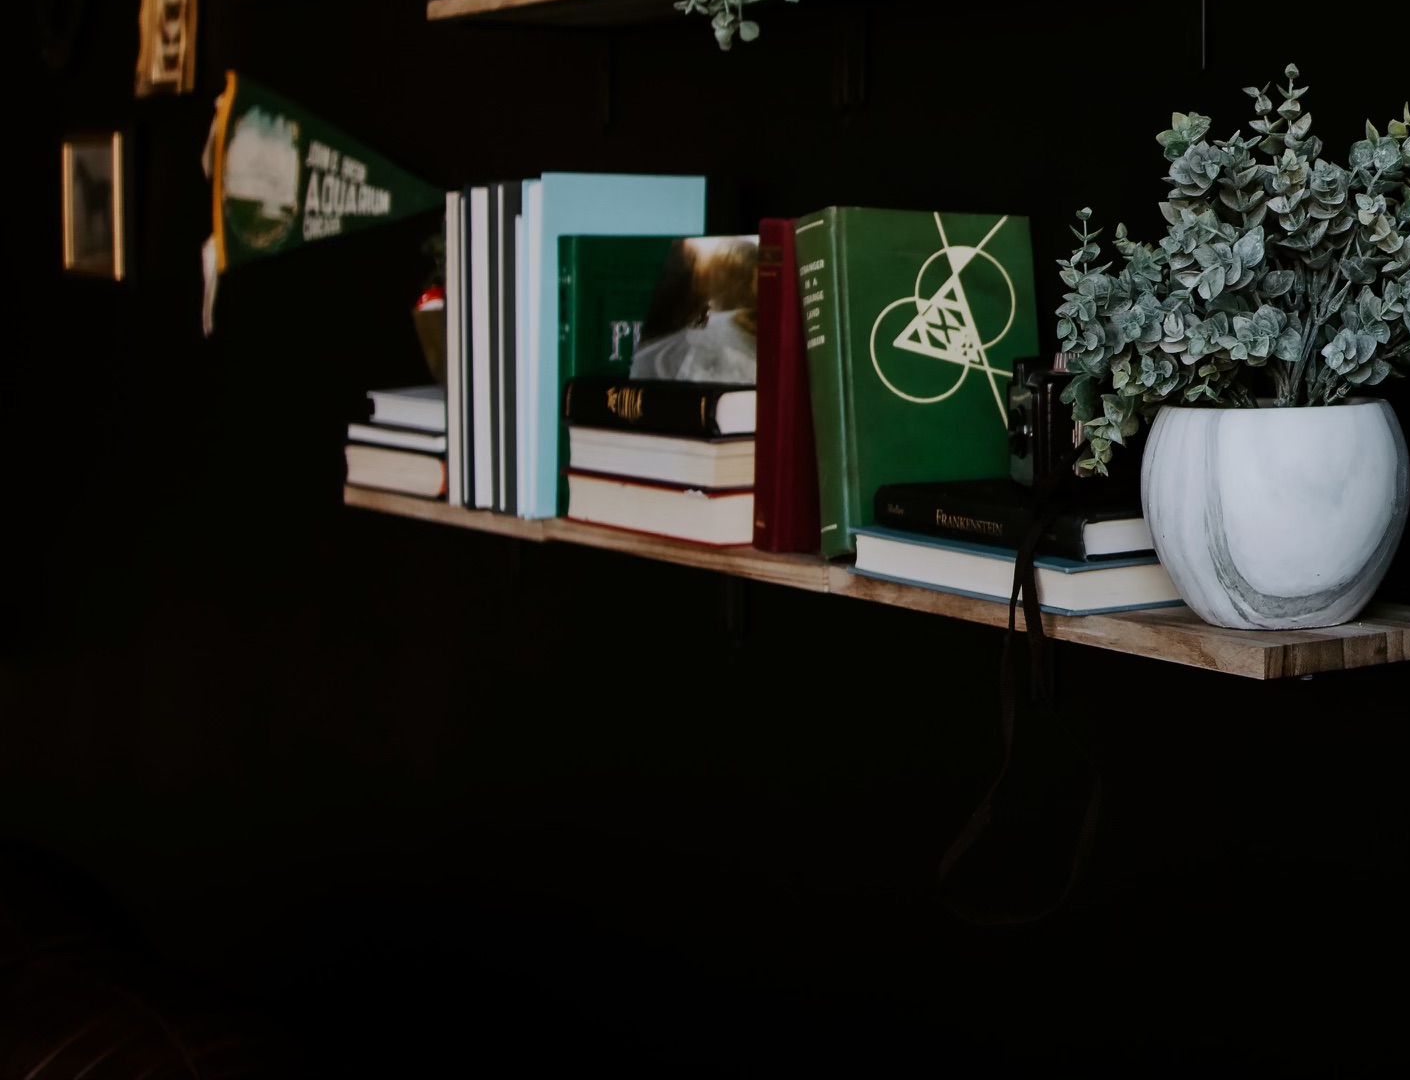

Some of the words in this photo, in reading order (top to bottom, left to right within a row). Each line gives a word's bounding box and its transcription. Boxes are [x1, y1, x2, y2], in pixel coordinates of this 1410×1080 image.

[303, 170, 392, 218] AQUARIUM
[804, 279, 811, 290] IN
[812, 277, 818, 287] A
[806, 307, 820, 321] LAND
[936, 508, 1004, 537] FRANKENSTEIN
